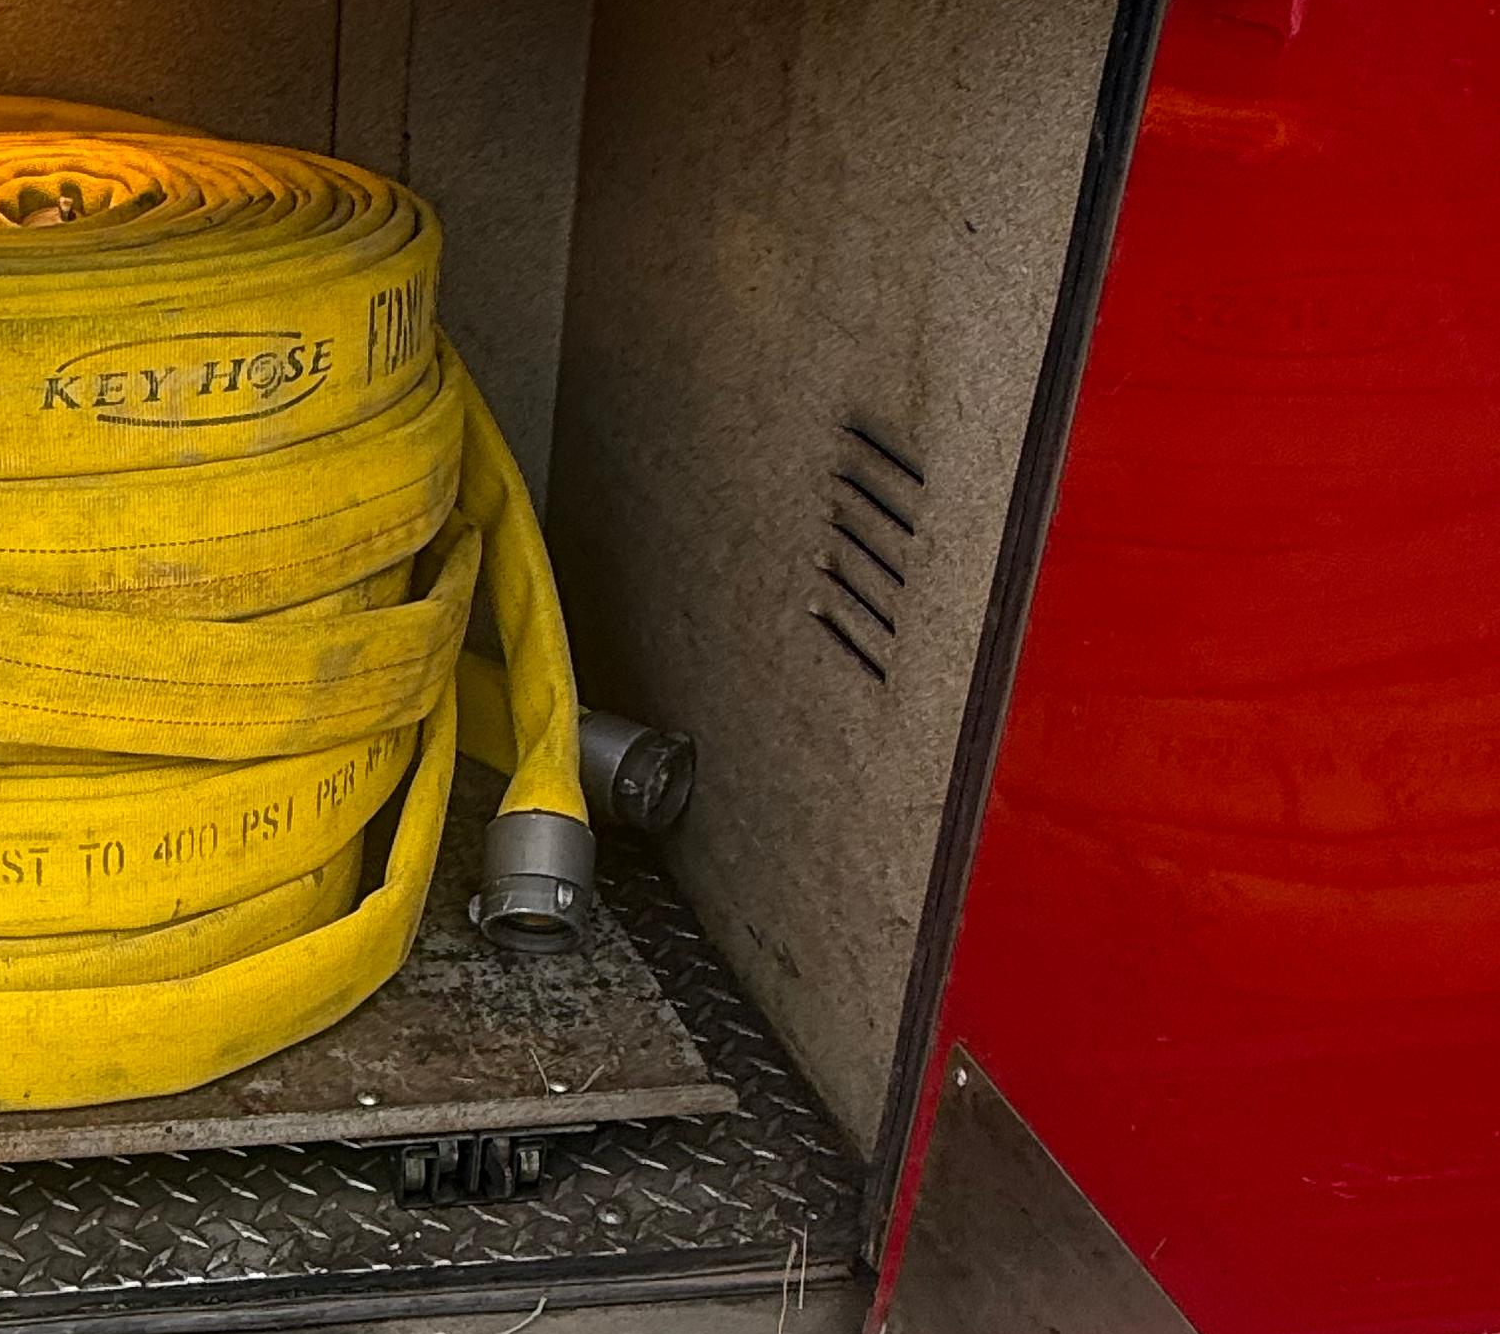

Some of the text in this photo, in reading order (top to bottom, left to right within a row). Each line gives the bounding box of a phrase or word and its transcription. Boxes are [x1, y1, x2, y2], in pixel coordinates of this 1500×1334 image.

[41, 366, 175, 411] KEY
[197, 338, 335, 399] HOSE
[78, 840, 125, 878] TO
[152, 822, 218, 867] 400
[242, 796, 294, 848] PSI
[316, 760, 355, 819] PER
